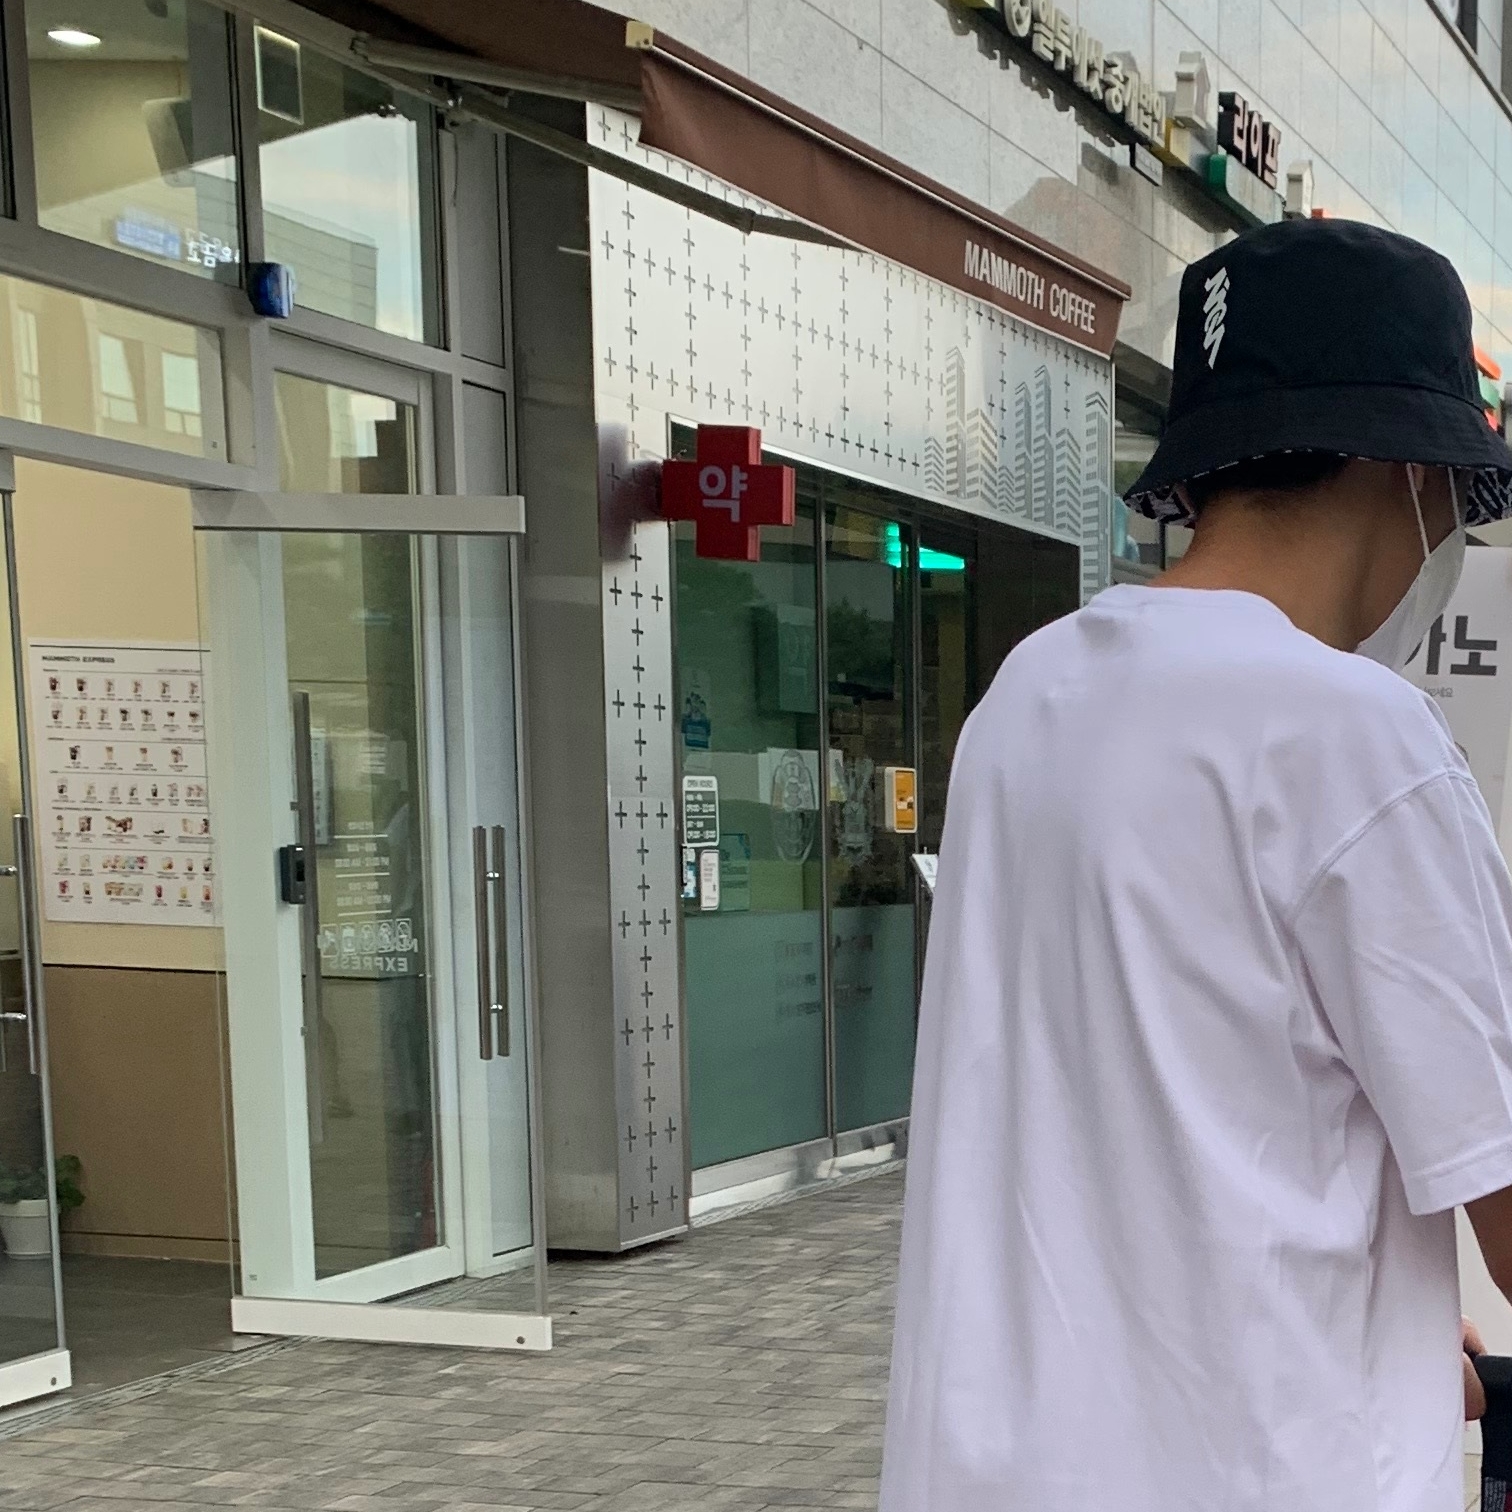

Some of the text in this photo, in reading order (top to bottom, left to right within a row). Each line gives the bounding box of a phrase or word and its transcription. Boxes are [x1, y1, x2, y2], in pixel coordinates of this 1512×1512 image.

[964, 239, 1096, 335] MAMMOTH COFFEE
[698, 464, 749, 523] 약
